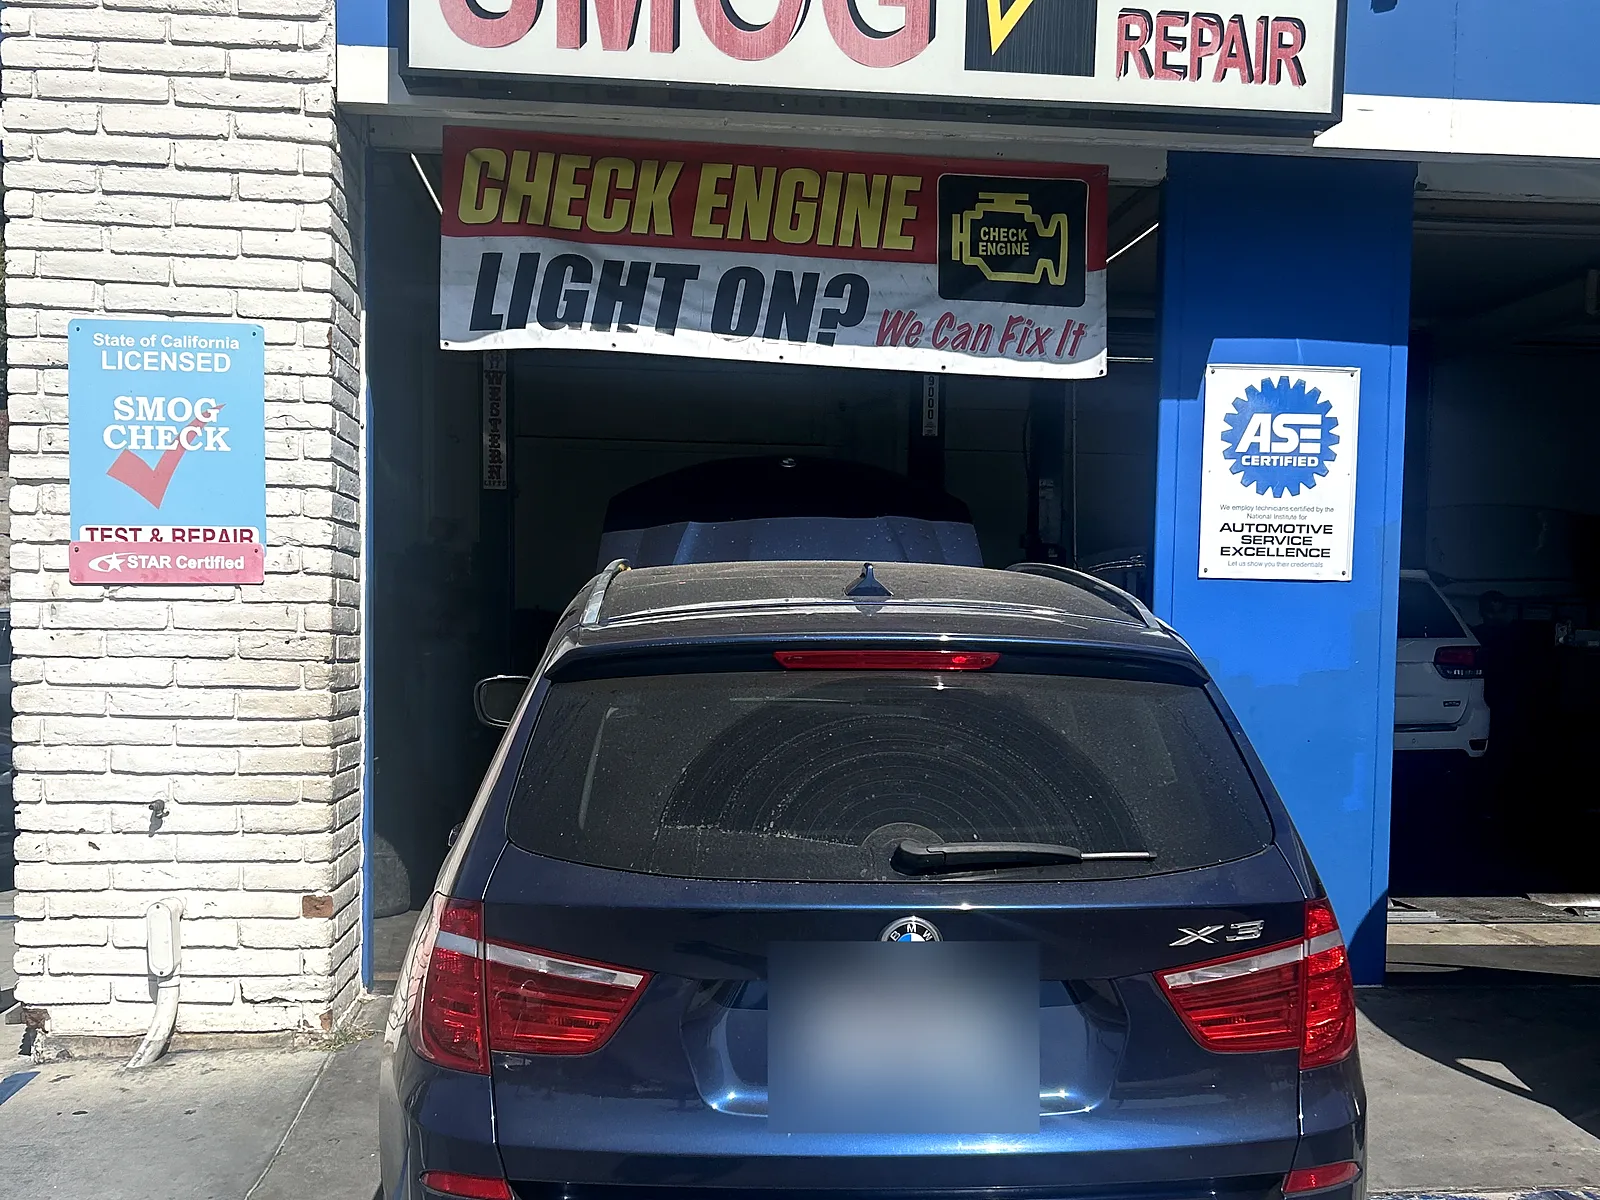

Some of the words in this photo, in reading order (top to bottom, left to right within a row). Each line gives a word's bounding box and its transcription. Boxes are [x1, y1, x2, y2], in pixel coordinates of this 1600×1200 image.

[1115, 7, 1307, 88] REPAIR
[457, 147, 685, 236] CHECK
[691, 162, 922, 250] ENGINE
[979, 226, 1028, 242] CHECK
[978, 240, 1030, 256] ENGINE
[469, 252, 700, 337] LIGHT
[710, 265, 870, 347] ON?
[93, 333, 135, 347] State
[139, 334, 157, 347] of
[160, 334, 240, 350] California
[876, 308, 925, 348] We
[931, 311, 994, 353] Can
[998, 314, 1053, 357] Fix
[1055, 318, 1086, 358] It
[101, 350, 231, 373] LICENSED
[927, 375, 935, 420] 9000
[113, 395, 220, 423] SMOG
[103, 424, 231, 451] CHECK
[1234, 413, 1322, 454] ASE
[1241, 455, 1319, 468] CERTIFIED
[1316, 506, 1323, 514] by
[85, 527, 142, 542] TEST
[149, 528, 163, 542] &
[171, 528, 254, 543] REPAIR
[1219, 523, 1333, 534] AUTOMOTIVE
[1241, 535, 1313, 546] SERVICE
[1220, 546, 1331, 558] EXCELLENCE
[127, 555, 172, 569] STAR
[175, 555, 245, 570] Certified
[890, 923, 933, 942] BMW
[1169, 920, 1265, 947] X3
